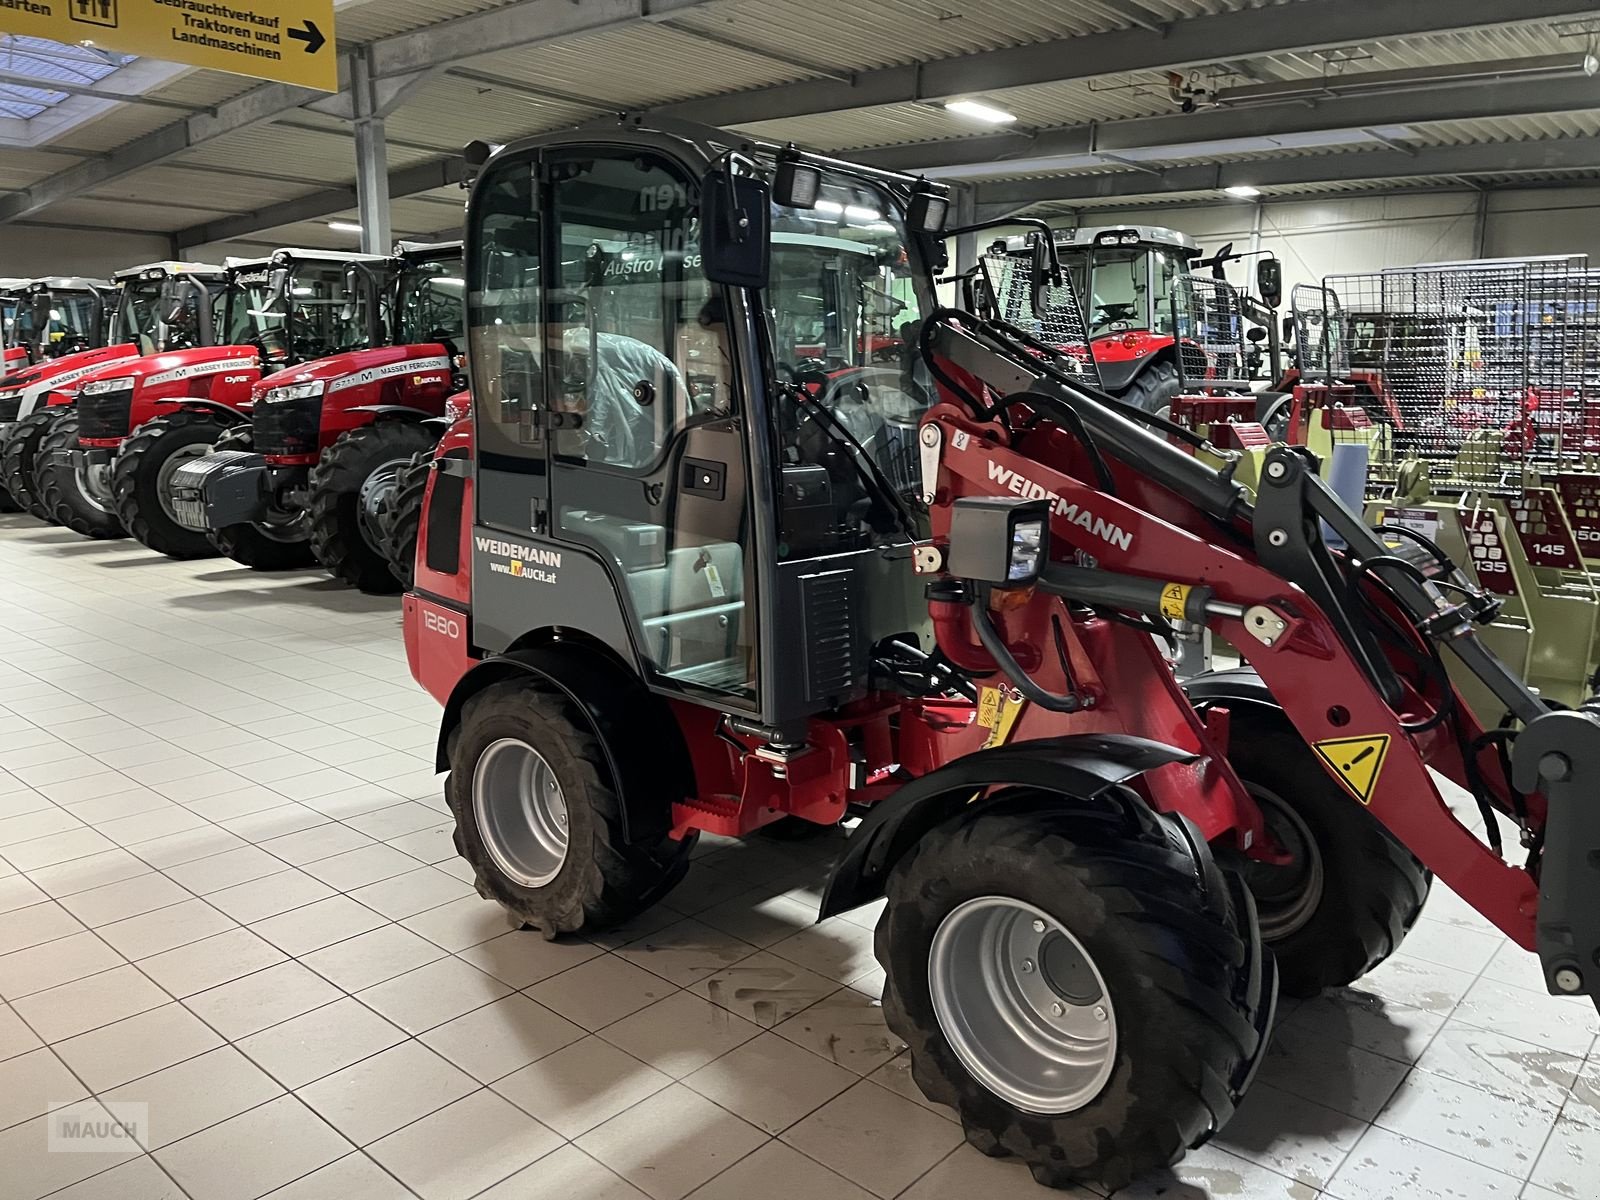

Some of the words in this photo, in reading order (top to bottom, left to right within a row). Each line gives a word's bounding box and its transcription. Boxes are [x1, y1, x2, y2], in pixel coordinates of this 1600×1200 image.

[0, 0, 51, 16] arten
[181, 12, 251, 38] Traktoren
[254, 30, 281, 45] und
[171, 27, 282, 61] Landmaschinen
[603, 258, 654, 276] Austro
[175, 368, 187, 378] M
[193, 363, 221, 373] MASSEY
[335, 378, 355, 388] 5711
[361, 371, 372, 381] M
[380, 364, 407, 375] MASSEY
[409, 360, 441, 370] FERGUSON
[988, 460, 1133, 551] WEIDEMANN
[475, 536, 561, 568] WEIDEMANN
[1532, 543, 1566, 556] 145
[1473, 560, 1508, 573] 135
[423, 610, 459, 638] 1280
